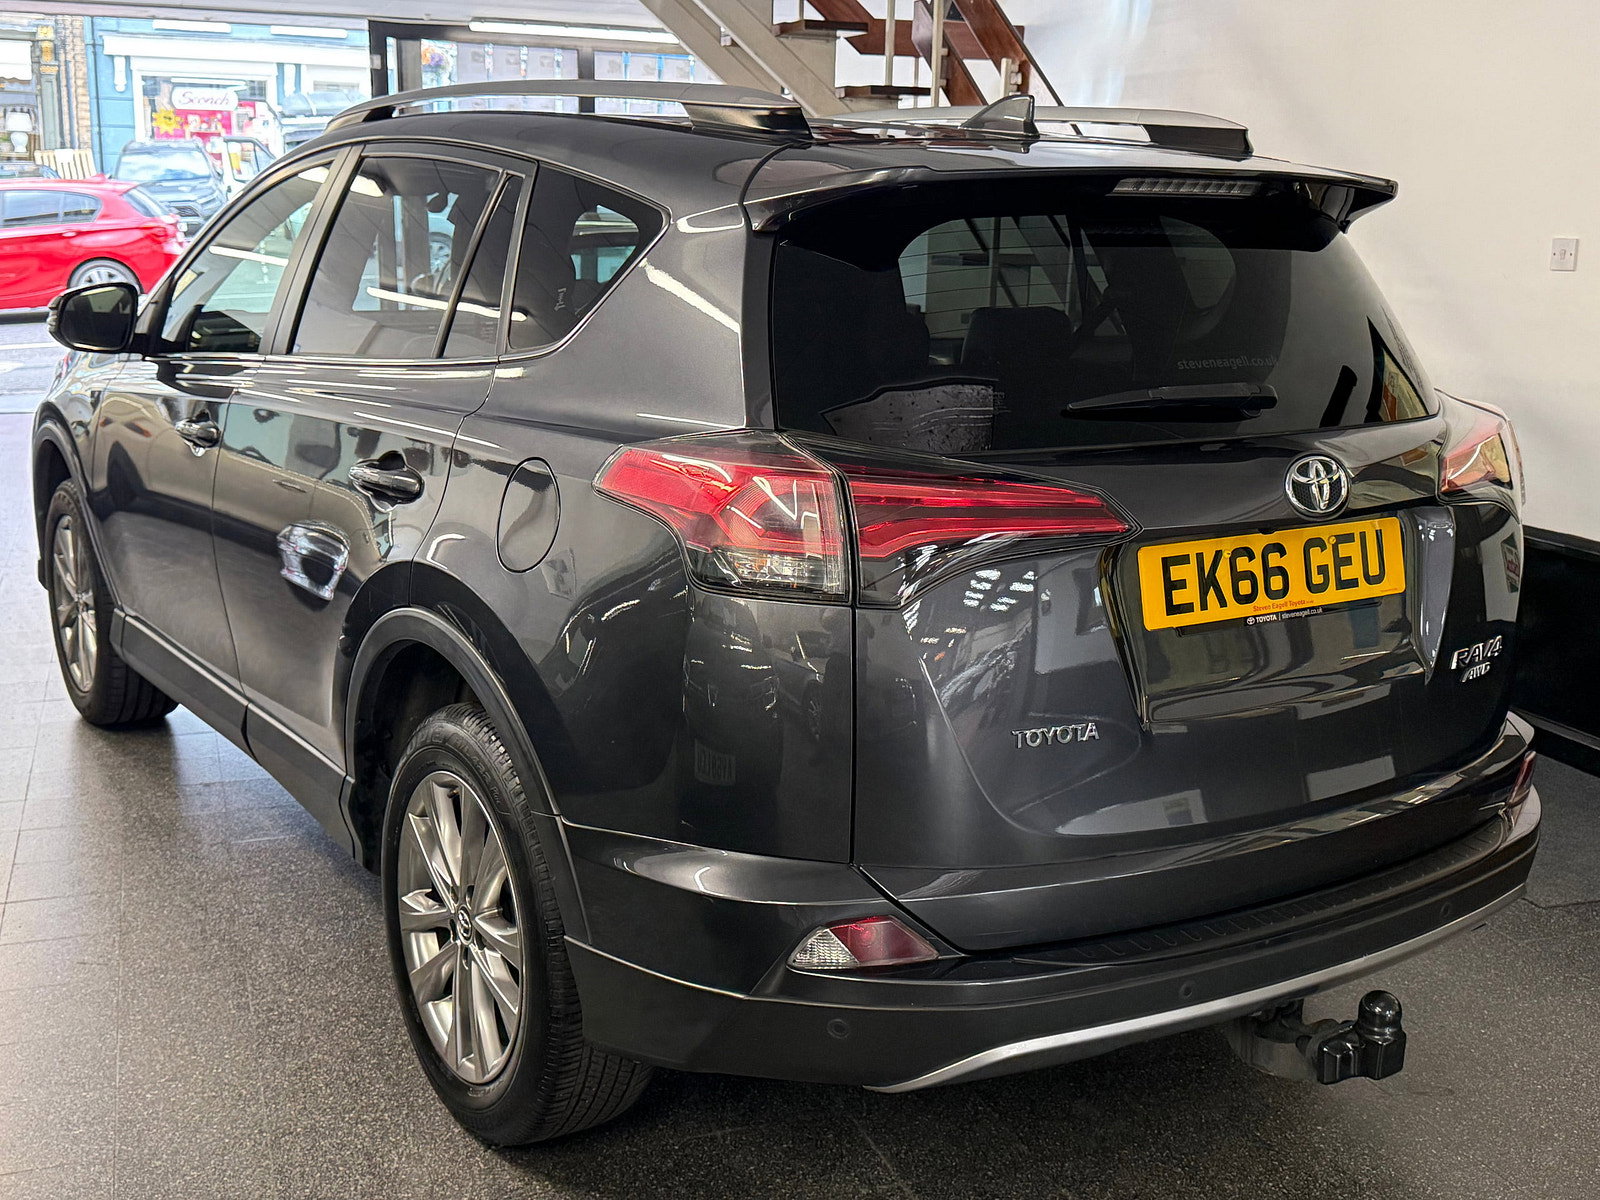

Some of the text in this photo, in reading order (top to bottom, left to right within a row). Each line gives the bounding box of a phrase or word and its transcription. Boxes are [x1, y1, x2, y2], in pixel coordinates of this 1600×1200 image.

[1177, 355, 1280, 370] steveneagell.co.uk
[1161, 529, 1386, 617] EK66 GEU
[1253, 604, 1271, 612] Steven
[1272, 602, 1288, 610] Eagell
[1289, 599, 1306, 608] Toyota
[1256, 614, 1277, 623] TOYOTA
[1450, 635, 1503, 670] RAV4
[1461, 661, 1491, 683] AWD
[1010, 722, 1100, 749] TOYOTA
